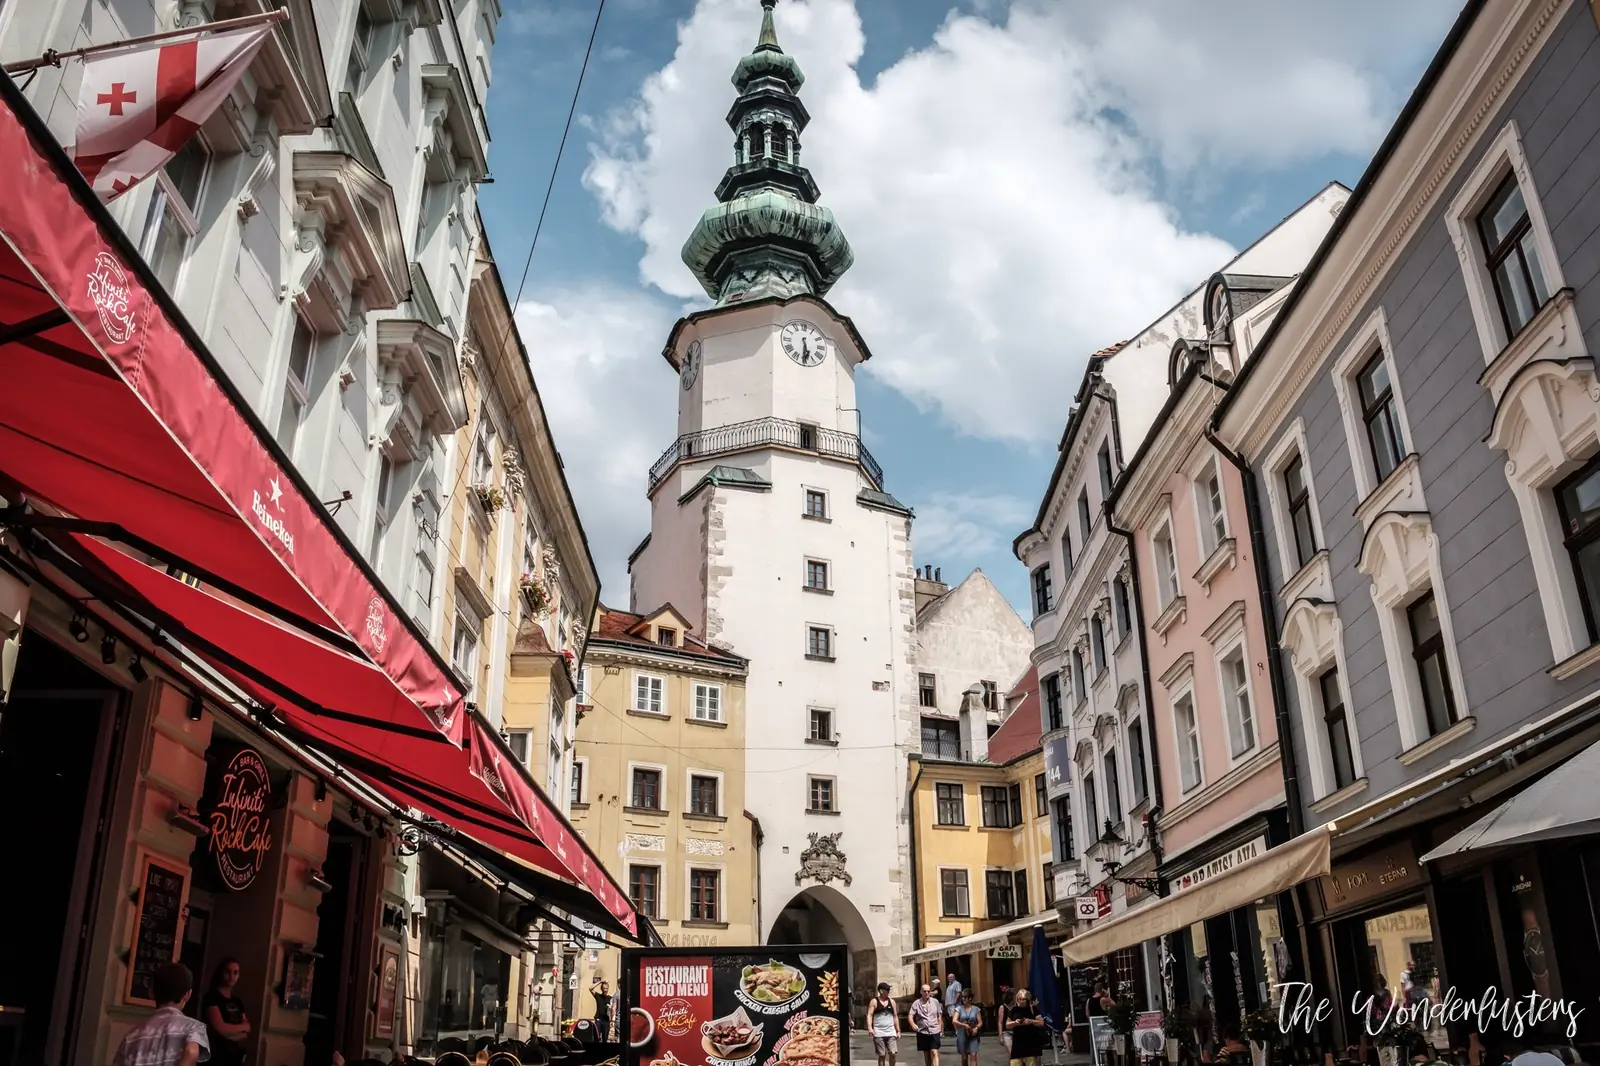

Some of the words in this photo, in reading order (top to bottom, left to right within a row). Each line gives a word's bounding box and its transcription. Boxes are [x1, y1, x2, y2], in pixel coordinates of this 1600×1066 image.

[100, 307, 125, 340] RESTAURANT
[252, 489, 294, 555] Heineken
[217, 773, 266, 830] Infiniti
[221, 853, 254, 884] RESTAURANT
[1379, 867, 1409, 885] ETERNA
[645, 965, 709, 984] RESTAURANT
[645, 983, 675, 997] FOOD
[677, 983, 709, 997] MENU
[733, 989, 762, 1013] CHICKEN
[761, 1003, 791, 1016] CAESAR
[790, 990, 811, 1012] SALAD
[658, 1006, 689, 1022] Infiniti
[783, 1010, 808, 1031] VEGGIE
[705, 1056, 735, 1066] CHICKEN
[735, 1055, 757, 1066] WINGS
